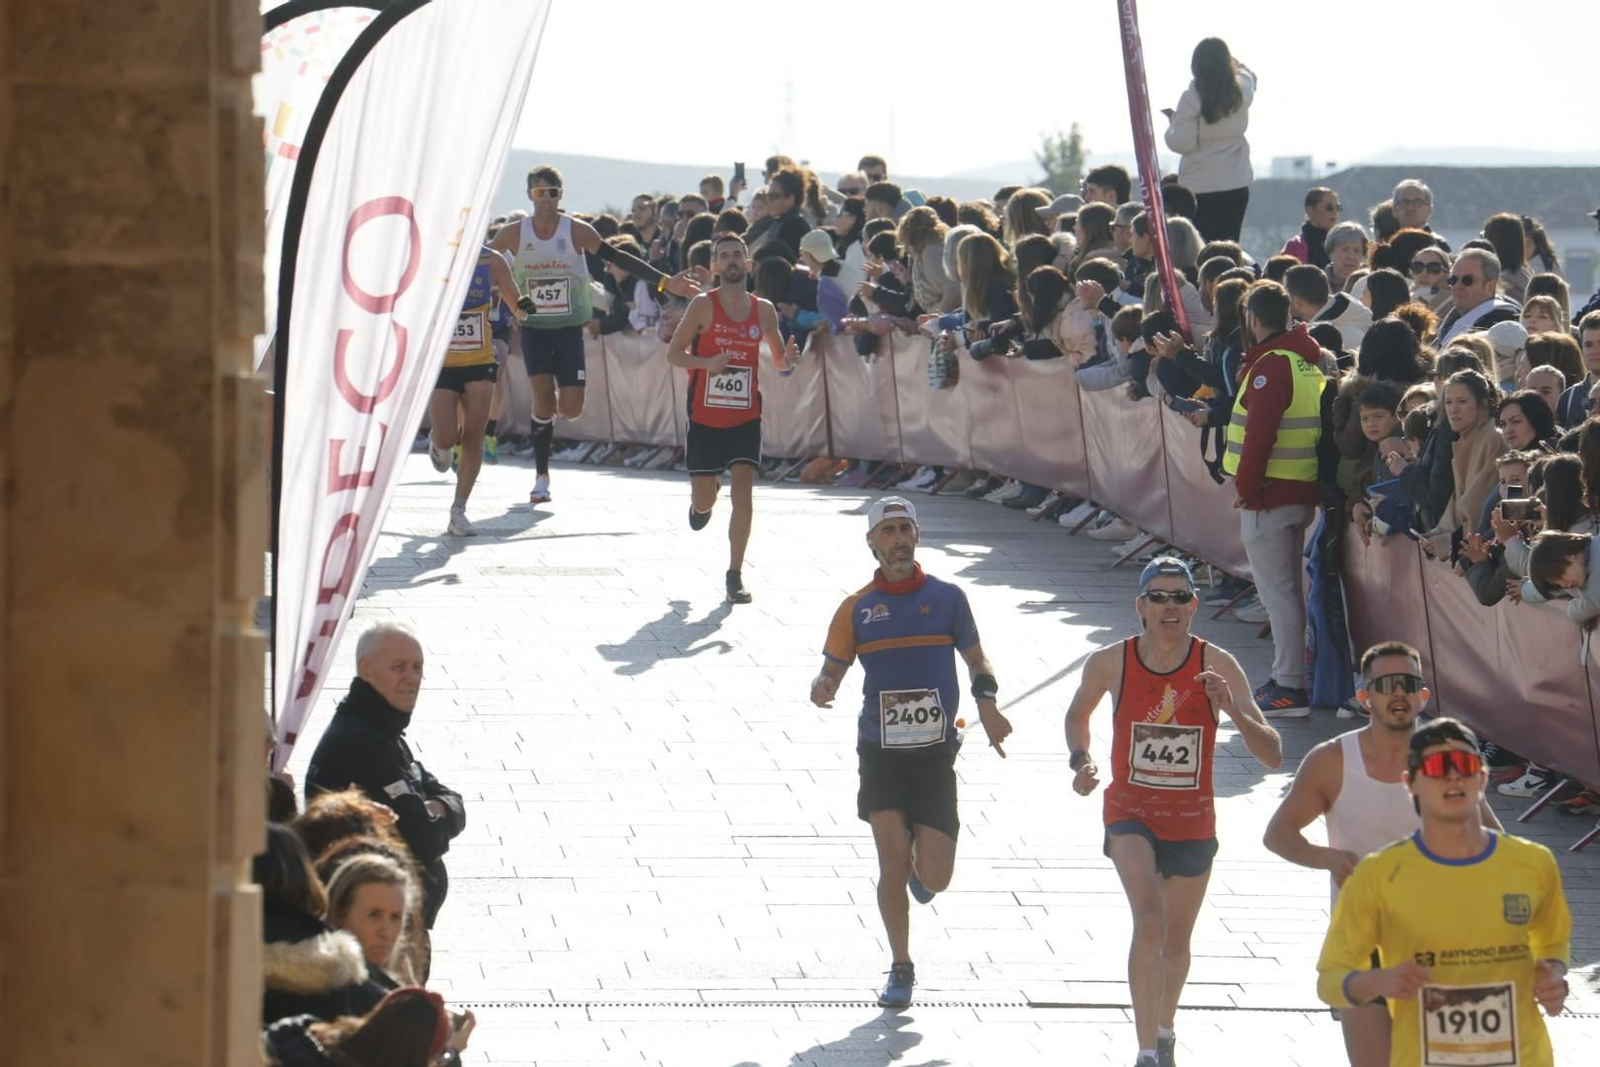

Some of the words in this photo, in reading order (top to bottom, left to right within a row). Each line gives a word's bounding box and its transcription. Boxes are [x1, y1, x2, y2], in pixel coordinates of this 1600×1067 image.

[536, 289, 561, 301] 457
[714, 378, 743, 392] 460
[885, 705, 942, 726] 2409
[1141, 743, 1190, 765] 442
[1436, 1009, 1502, 1035] 1910
